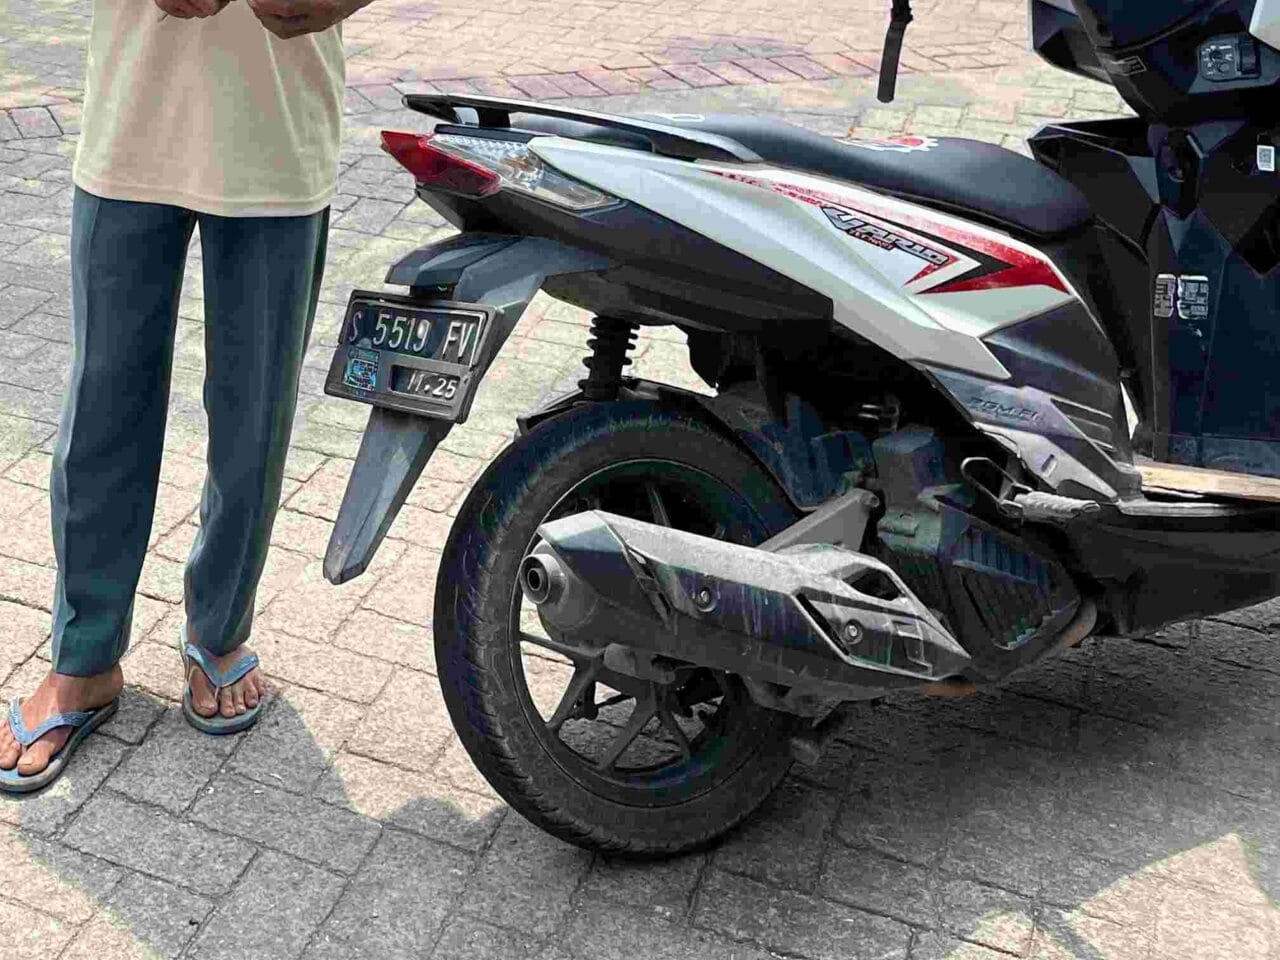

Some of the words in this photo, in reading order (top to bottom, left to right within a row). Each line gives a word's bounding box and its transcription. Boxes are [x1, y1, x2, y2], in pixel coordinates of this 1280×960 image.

[348, 310, 362, 342] S
[373, 313, 431, 353] 5519
[442, 320, 476, 358] FV
